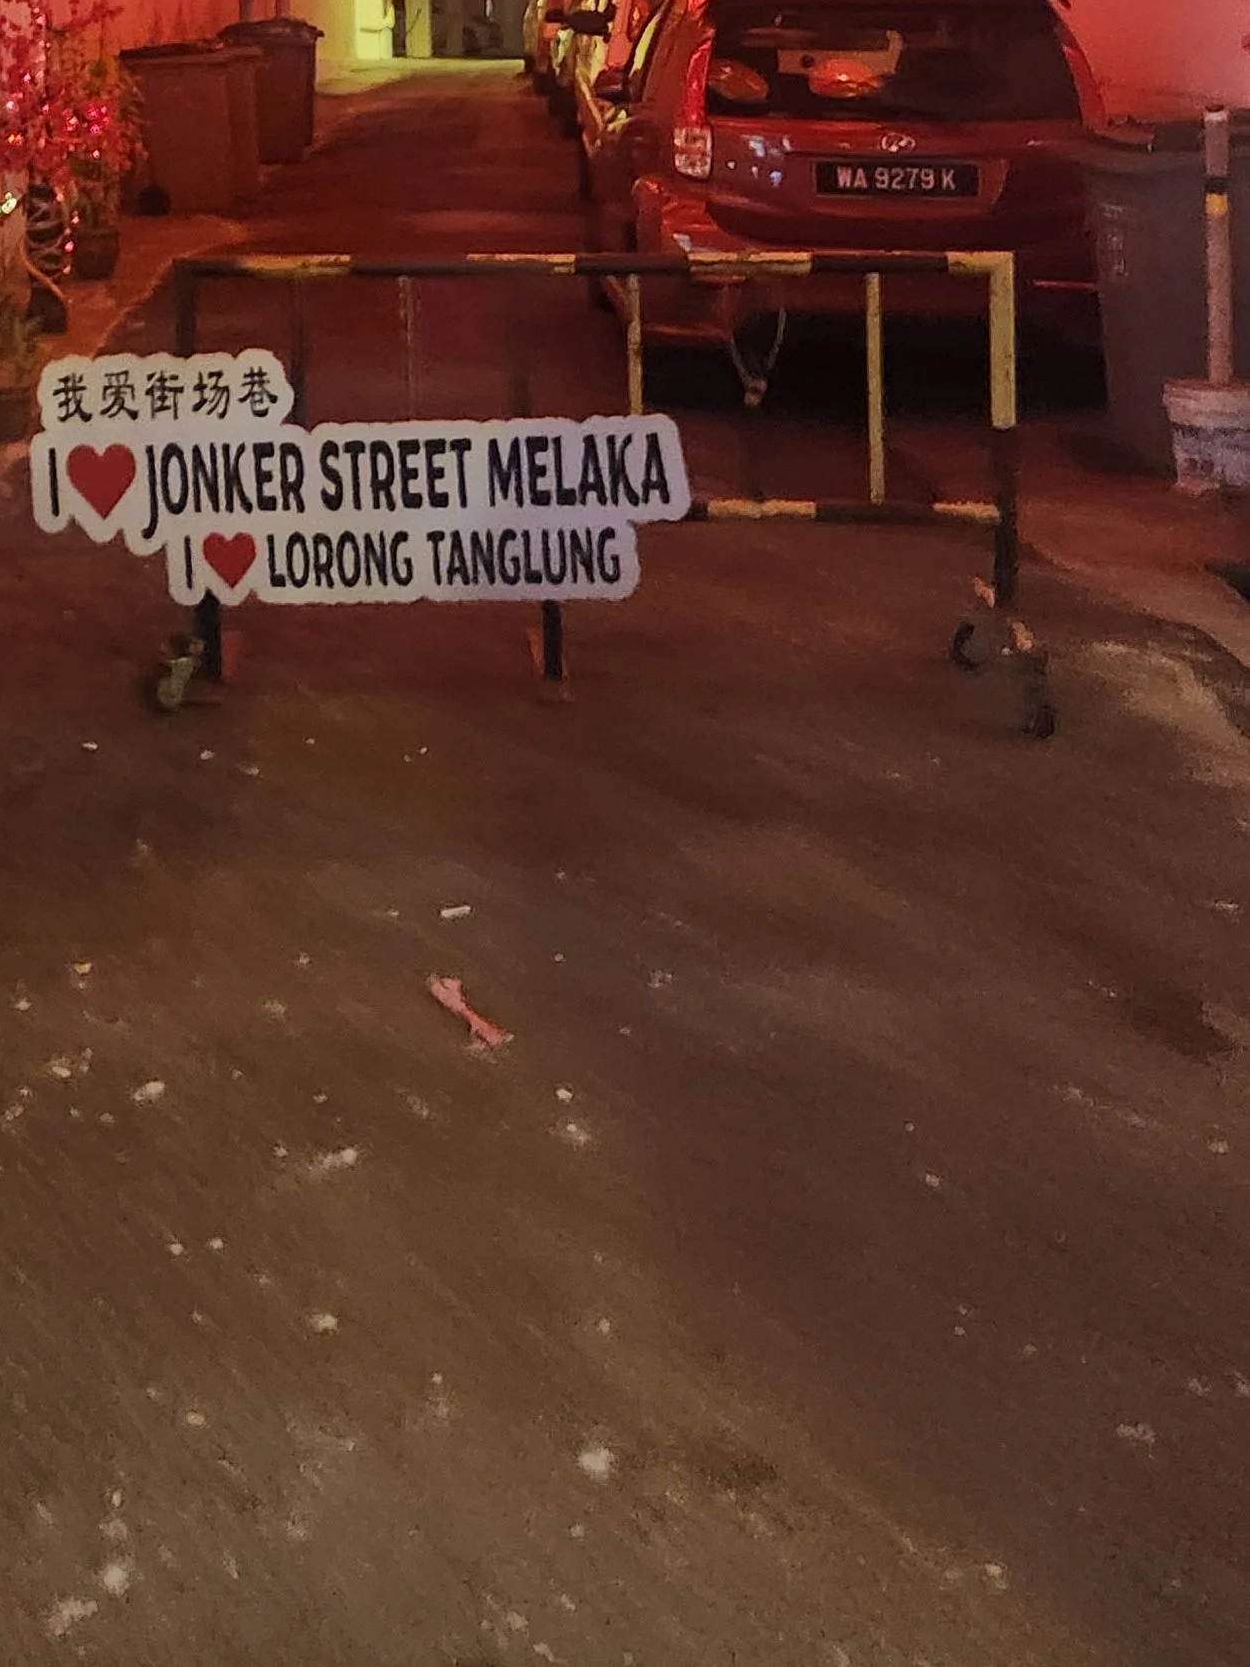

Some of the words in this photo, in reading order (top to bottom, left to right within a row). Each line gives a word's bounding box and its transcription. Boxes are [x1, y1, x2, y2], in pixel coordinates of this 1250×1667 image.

[836, 165, 868, 190] WA
[873, 166, 936, 191] 9279
[940, 168, 957, 191] K
[52, 365, 279, 423] 我爱街场巷
[48, 446, 60, 518] I
[141, 441, 306, 540] JONKER
[319, 438, 472, 513] STREET
[487, 432, 671, 509] MELAKA
[183, 535, 194, 591] I
[267, 530, 414, 589] LORONG
[426, 526, 622, 587] TANGLUNG
